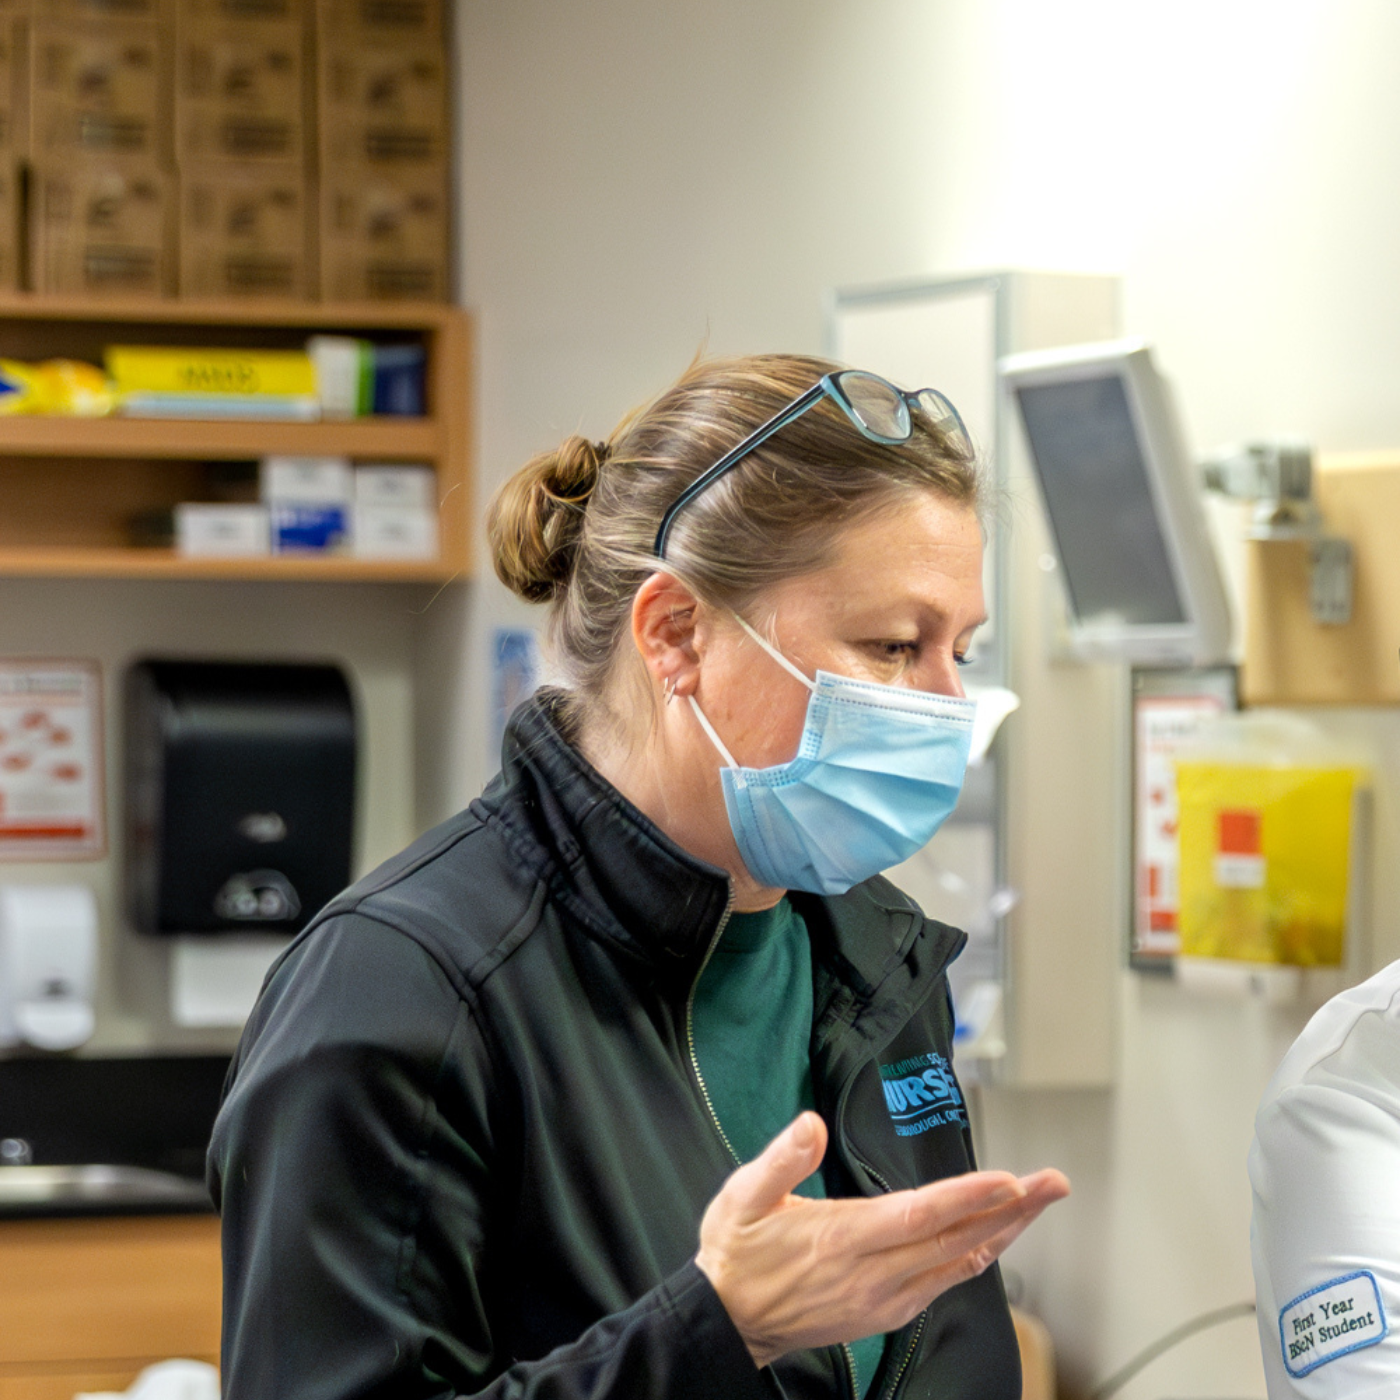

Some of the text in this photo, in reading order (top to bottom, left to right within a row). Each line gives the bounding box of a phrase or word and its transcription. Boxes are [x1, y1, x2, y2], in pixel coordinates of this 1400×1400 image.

[1288, 1311, 1375, 1360] BScN Student
[1292, 1297, 1354, 1335] First Year
